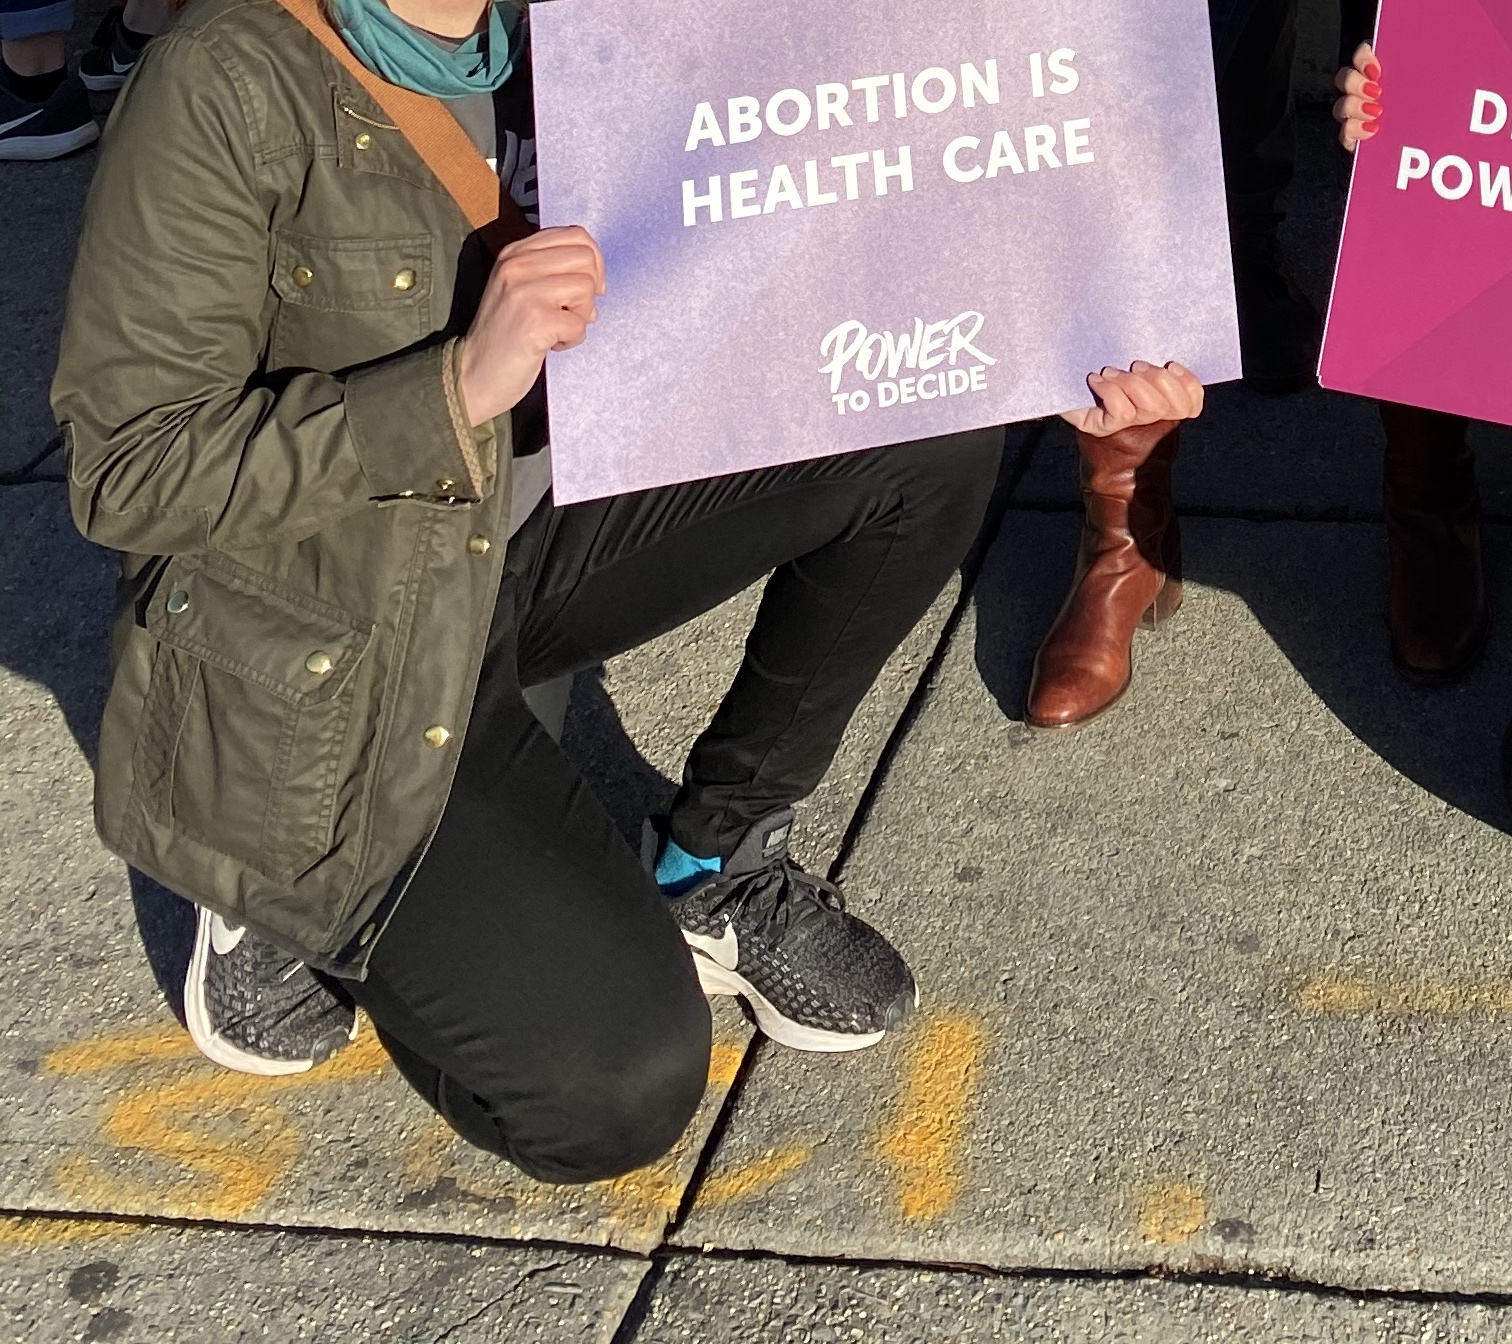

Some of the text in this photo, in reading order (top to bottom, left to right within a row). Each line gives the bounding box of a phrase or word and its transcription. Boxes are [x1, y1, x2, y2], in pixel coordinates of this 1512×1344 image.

[684, 47, 1080, 152] ABORTION IS
[681, 117, 1095, 227] HEALTH CARE
[818, 310, 998, 394] POWER
[831, 365, 988, 416] TO DECIDE
